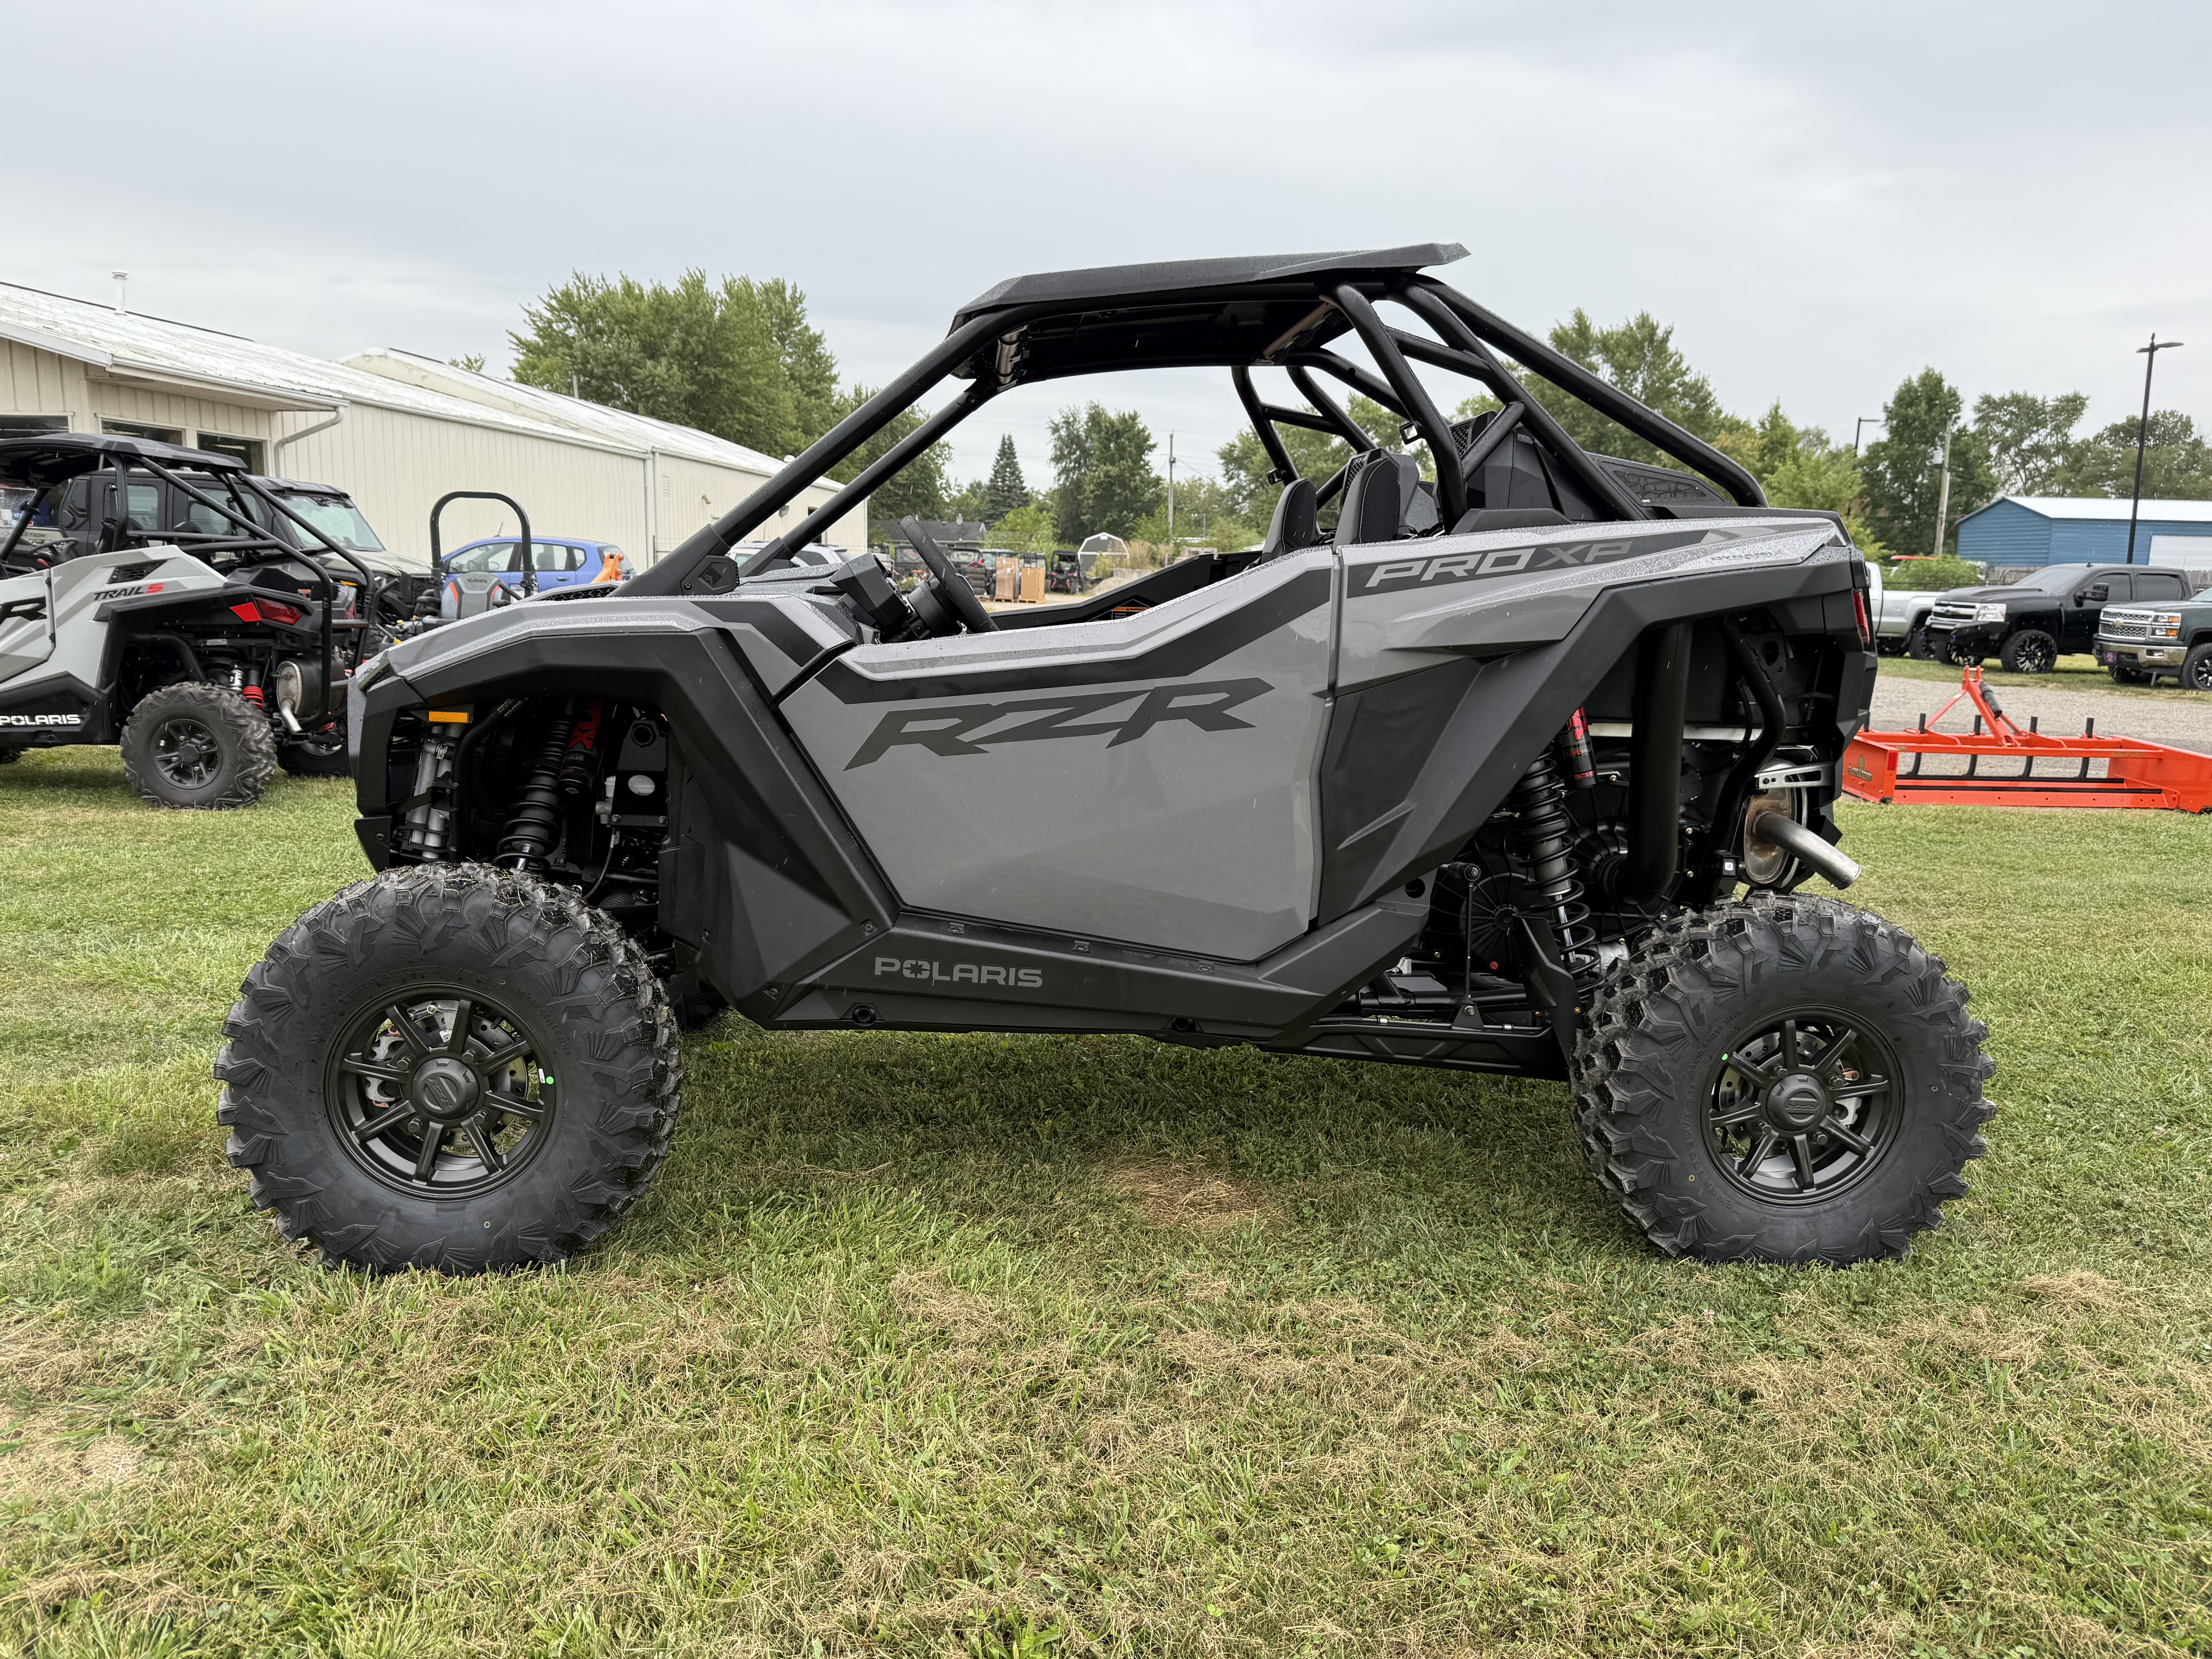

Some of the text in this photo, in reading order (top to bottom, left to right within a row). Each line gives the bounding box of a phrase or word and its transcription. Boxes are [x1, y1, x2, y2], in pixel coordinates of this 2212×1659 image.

[1365, 541, 1633, 587] PRO XP
[93, 582, 165, 601] TRAIL S
[0, 714, 81, 726] POLARIS
[843, 677, 1276, 771] RZR
[874, 957, 1043, 988] POLARIS
